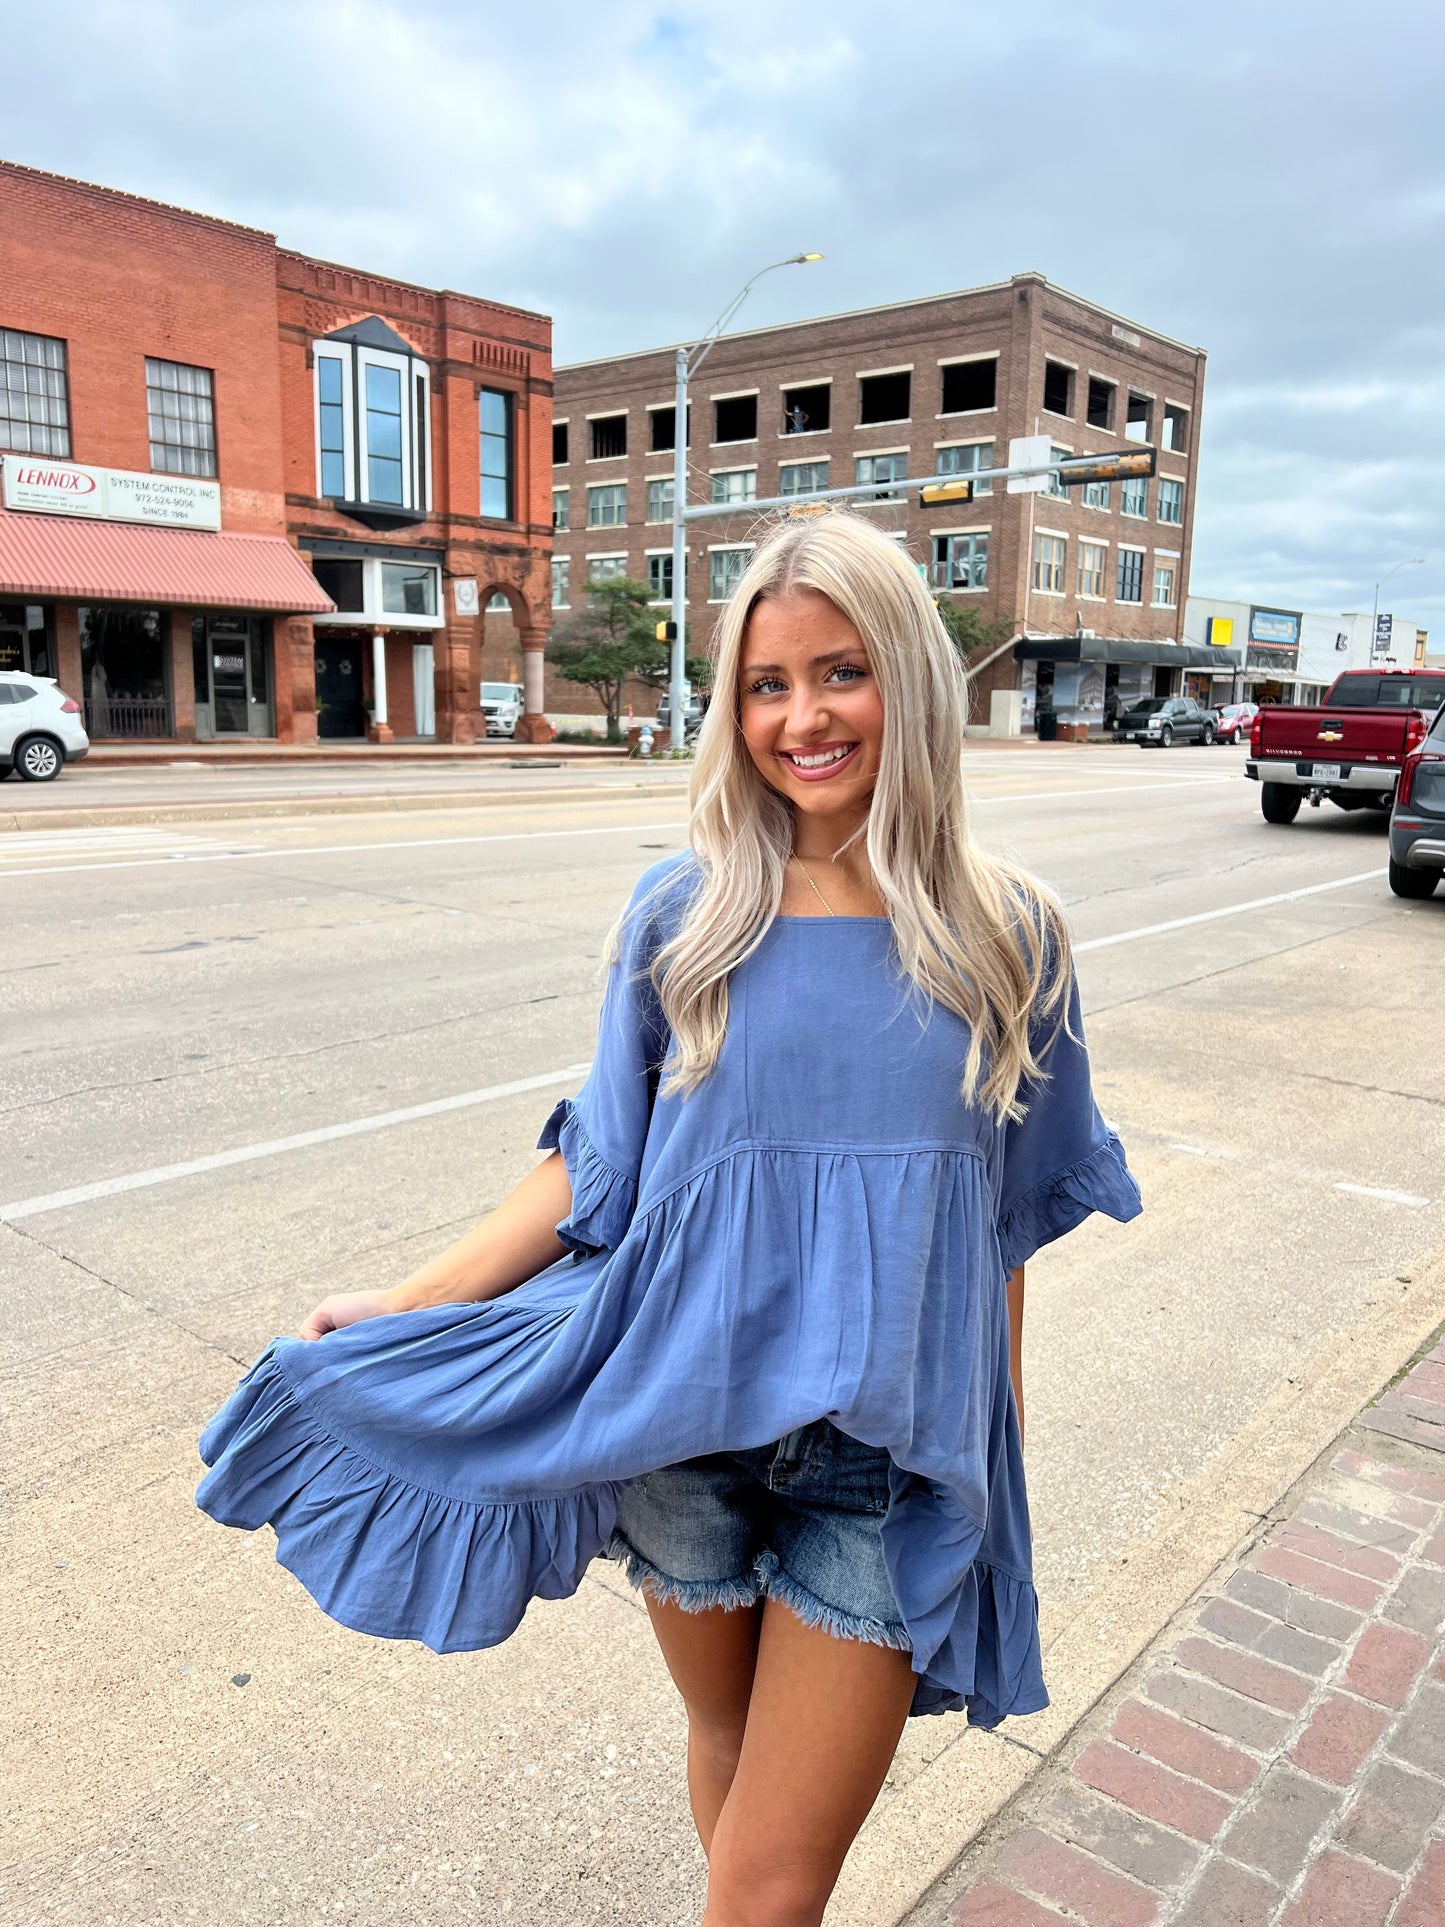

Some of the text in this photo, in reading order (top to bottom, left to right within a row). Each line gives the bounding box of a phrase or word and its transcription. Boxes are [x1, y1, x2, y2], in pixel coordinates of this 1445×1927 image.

[17, 468, 80, 490] LENNOX
[110, 477, 216, 499] SYSTEM CONTROL INC
[142, 506, 169, 517] SINCE
